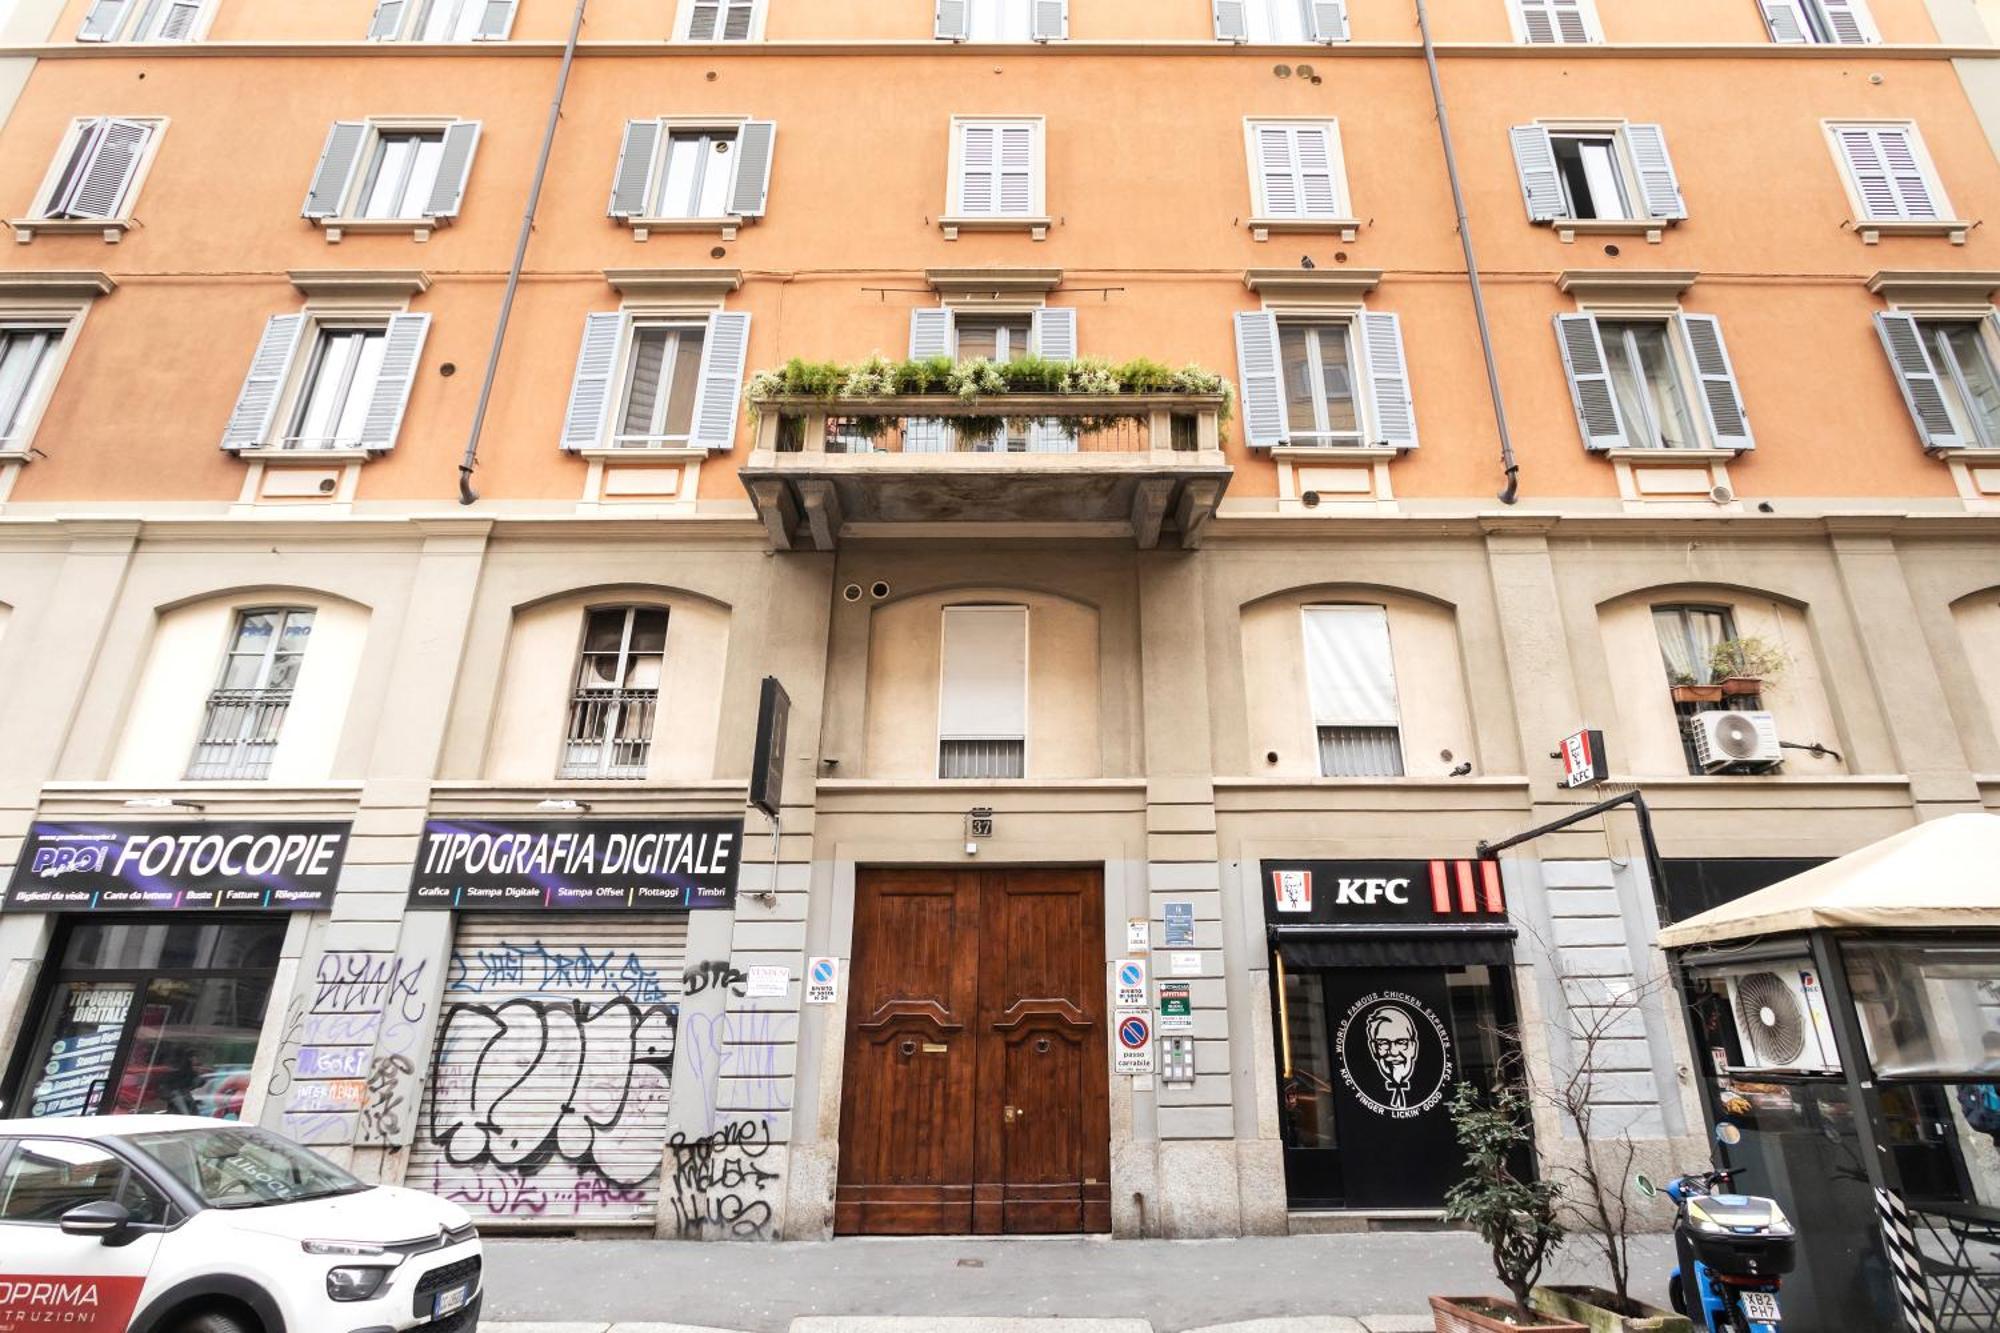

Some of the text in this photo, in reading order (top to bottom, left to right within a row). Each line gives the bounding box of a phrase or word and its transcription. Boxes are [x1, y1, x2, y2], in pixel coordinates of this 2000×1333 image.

[1572, 768, 1590, 785] KFC
[974, 820, 991, 835] 37
[112, 835, 341, 876] FOTOCOPIE
[424, 833, 733, 874] TIPOGRAFIA DIGITALE
[16, 891, 51, 902] Biglietti
[52, 891, 64, 900] da
[65, 891, 90, 900] visita
[129, 891, 142, 900] da
[186, 891, 212, 900] Buste
[227, 891, 260, 900] Fatture
[418, 887, 726, 898] Grafica Stampa Digitale Stampa Offset Plottaggi Timbri
[1335, 878, 1410, 904] KFC
[73, 1006, 128, 1022] DIGITALE
[1335, 990, 1452, 1053] WORLD FAMOUS CHICKEN EXPERTS
[1340, 1068, 1353, 1086] KFC
[1443, 1061, 1453, 1080] KFC
[1355, 1091, 1443, 1118] FINGER LICKIN' GOOD
[1746, 1293, 1773, 1306] XB2
[1750, 1305, 1774, 1318] PH7
